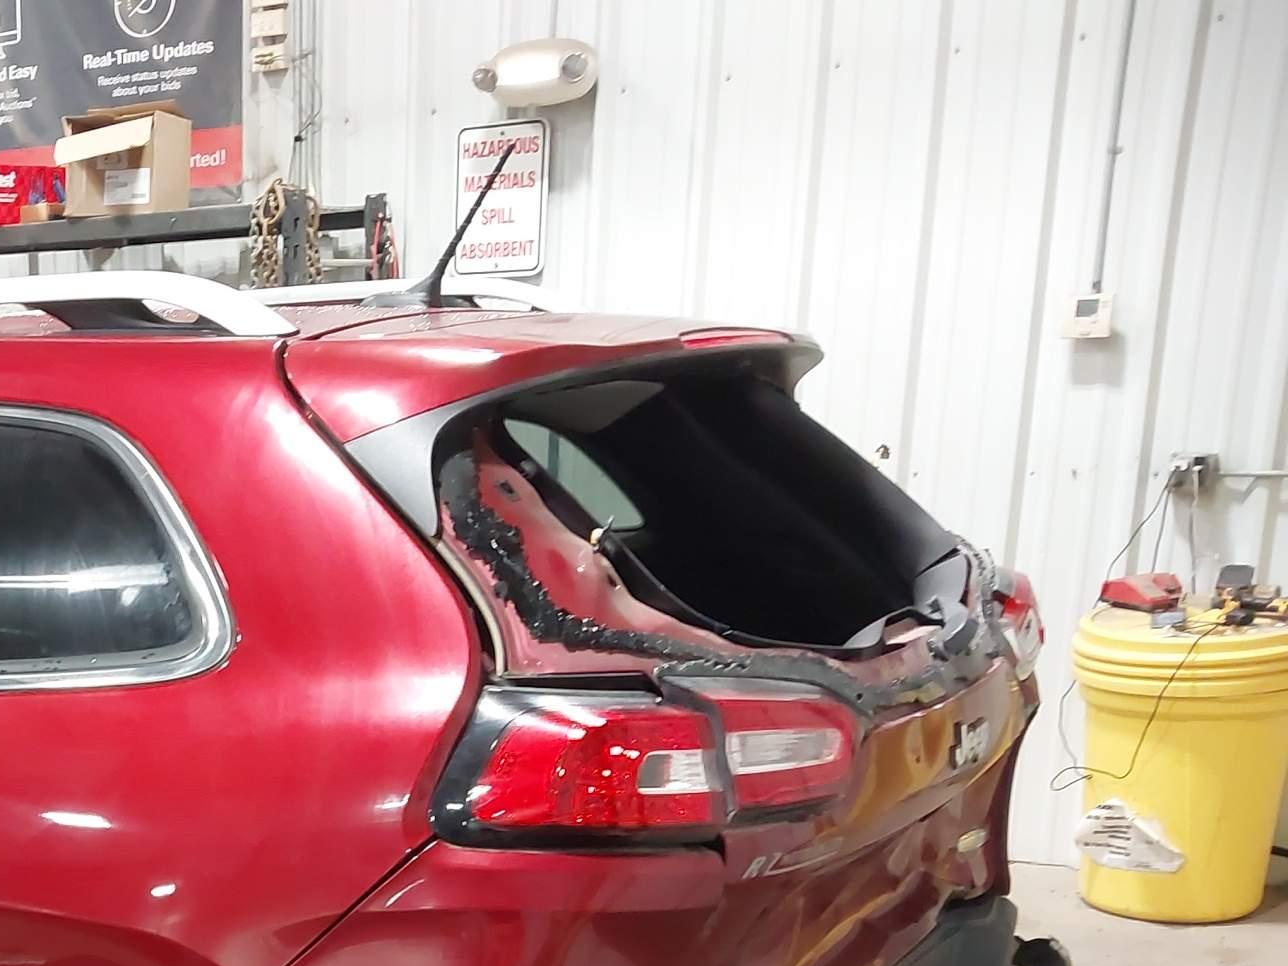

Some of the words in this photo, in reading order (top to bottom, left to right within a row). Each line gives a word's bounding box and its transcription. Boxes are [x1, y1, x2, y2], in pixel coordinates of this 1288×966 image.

[83, 48, 150, 70] Real-Time
[152, 40, 215, 62] Updates
[8, 64, 38, 80] Easy
[138, 83, 160, 96] your
[480, 207, 515, 225] SPILL
[460, 239, 535, 260] ABSORBENT
